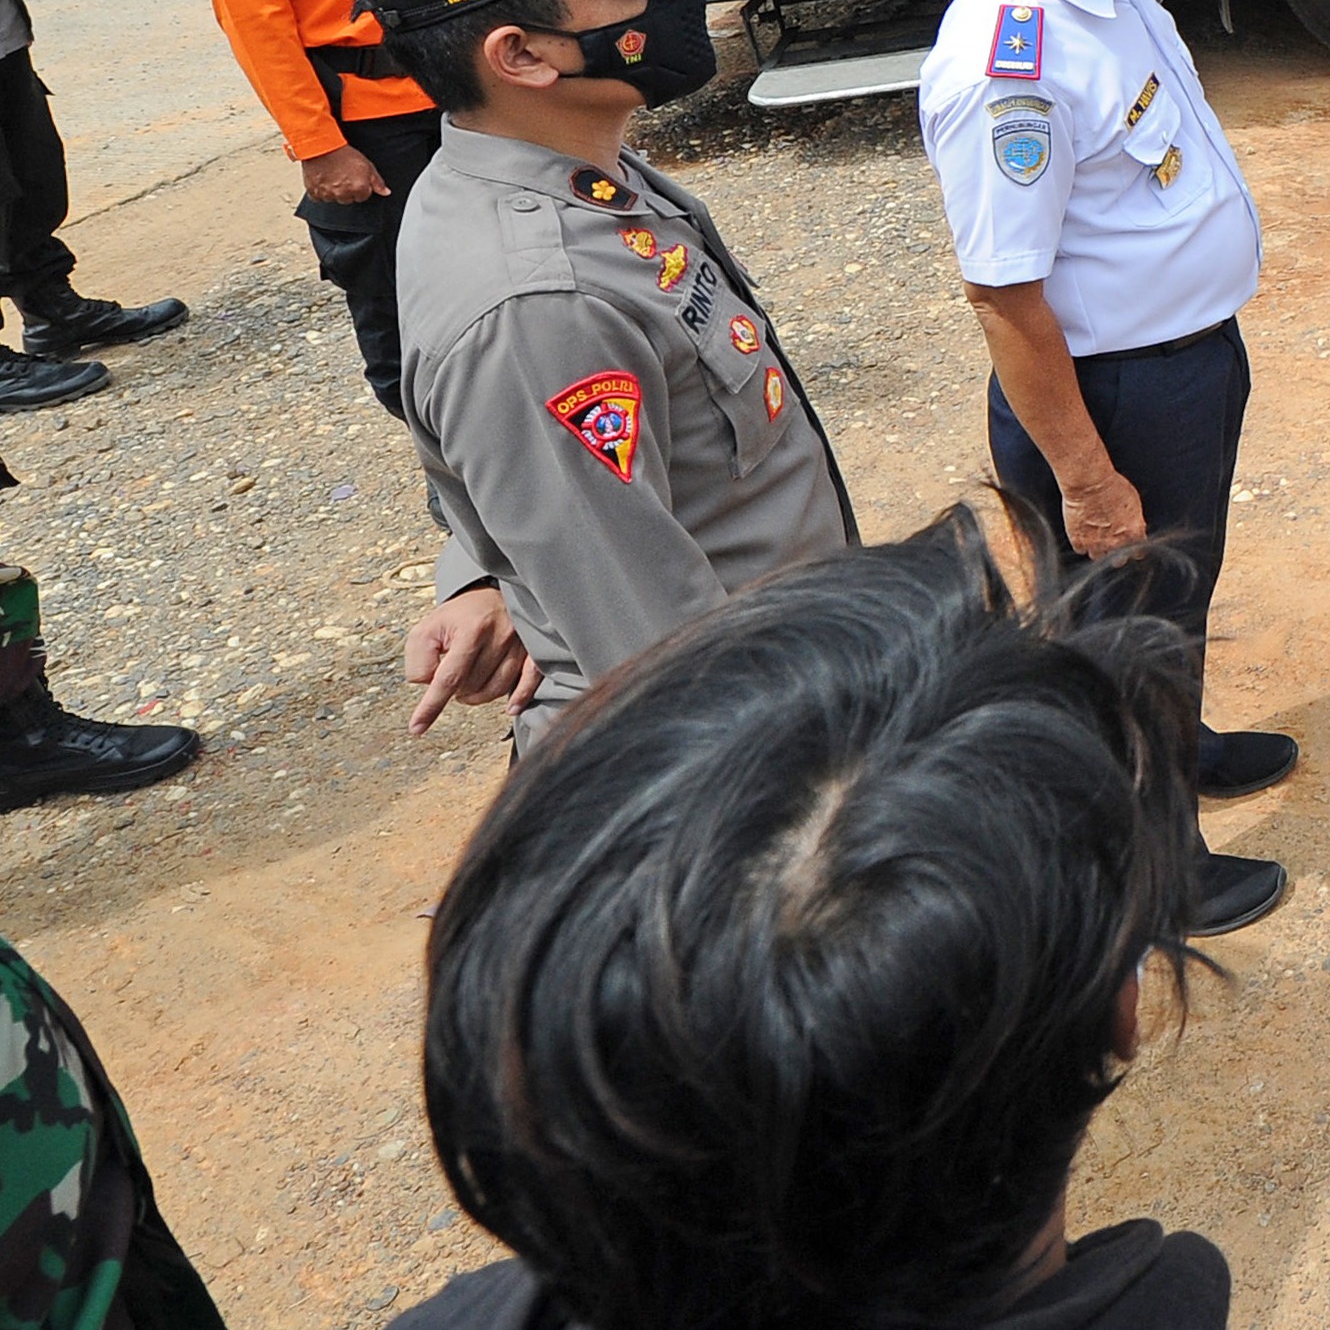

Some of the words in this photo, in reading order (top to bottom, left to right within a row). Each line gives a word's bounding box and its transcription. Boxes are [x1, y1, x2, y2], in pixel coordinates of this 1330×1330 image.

[682, 262, 717, 335] RINTO
[557, 389, 588, 413] OPS
[592, 380, 633, 395] POLRI
